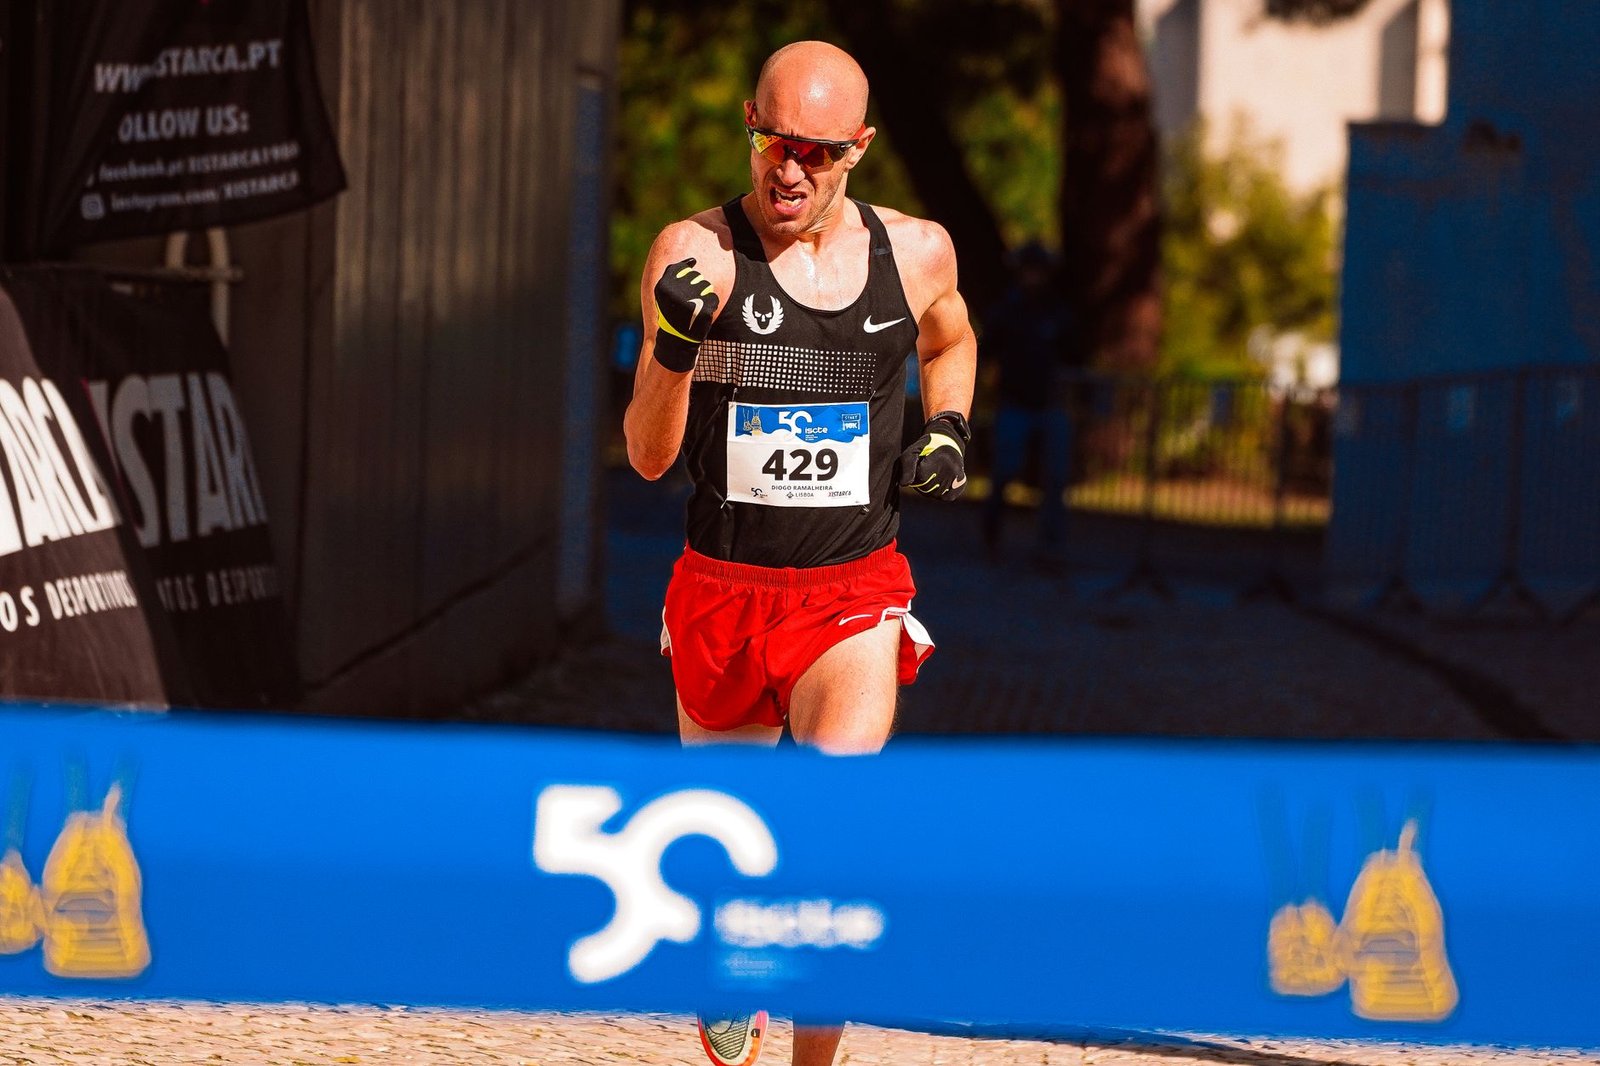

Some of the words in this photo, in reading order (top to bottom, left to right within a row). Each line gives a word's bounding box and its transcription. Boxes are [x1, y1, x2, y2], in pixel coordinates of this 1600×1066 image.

[118, 107, 199, 143] OLLOW
[205, 104, 250, 136] US:
[762, 448, 838, 481] 429
